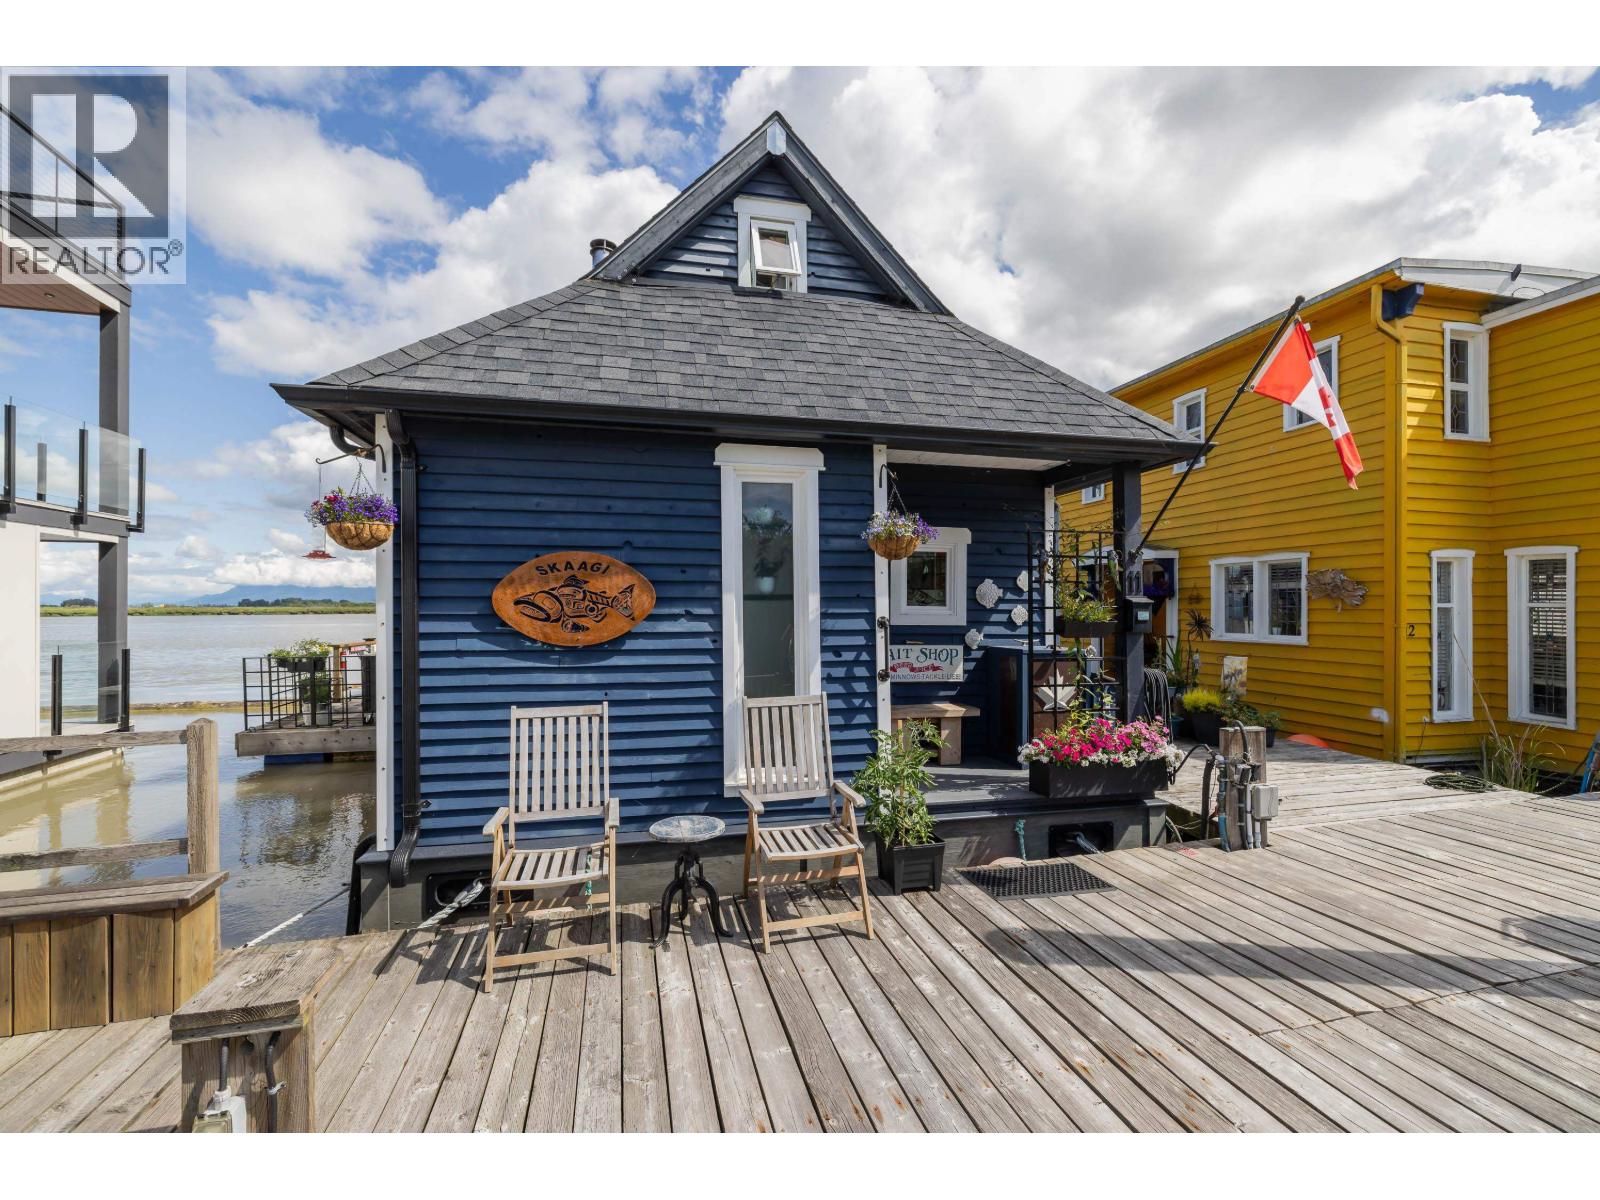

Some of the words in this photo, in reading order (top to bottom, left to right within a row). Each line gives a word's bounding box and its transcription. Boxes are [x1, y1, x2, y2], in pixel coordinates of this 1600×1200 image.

[535, 560, 610, 576] SKAAGI
[1408, 624, 1415, 637] 2
[889, 648, 913, 661] AIT
[916, 647, 959, 665] SHOP
